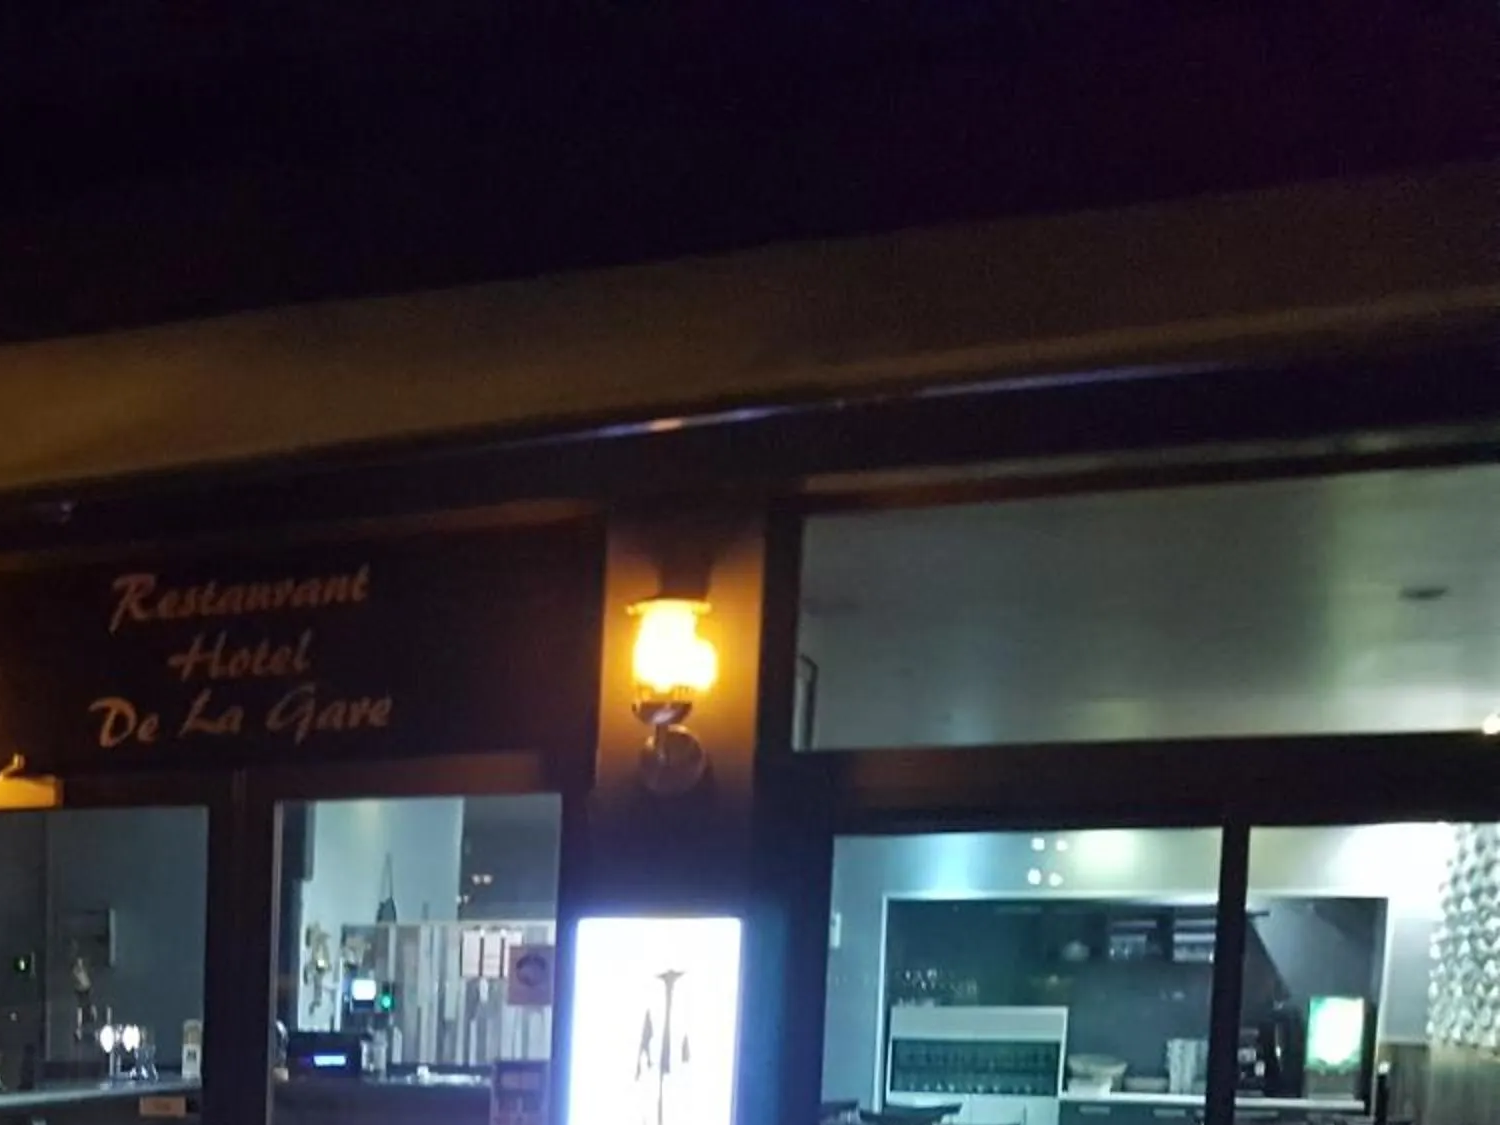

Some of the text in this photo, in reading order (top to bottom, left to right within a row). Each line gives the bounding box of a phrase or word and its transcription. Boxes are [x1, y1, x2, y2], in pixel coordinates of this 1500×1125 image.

[108, 563, 371, 635] Restaurant
[166, 628, 313, 682] Hotel
[88, 682, 394, 748] De La Gare
